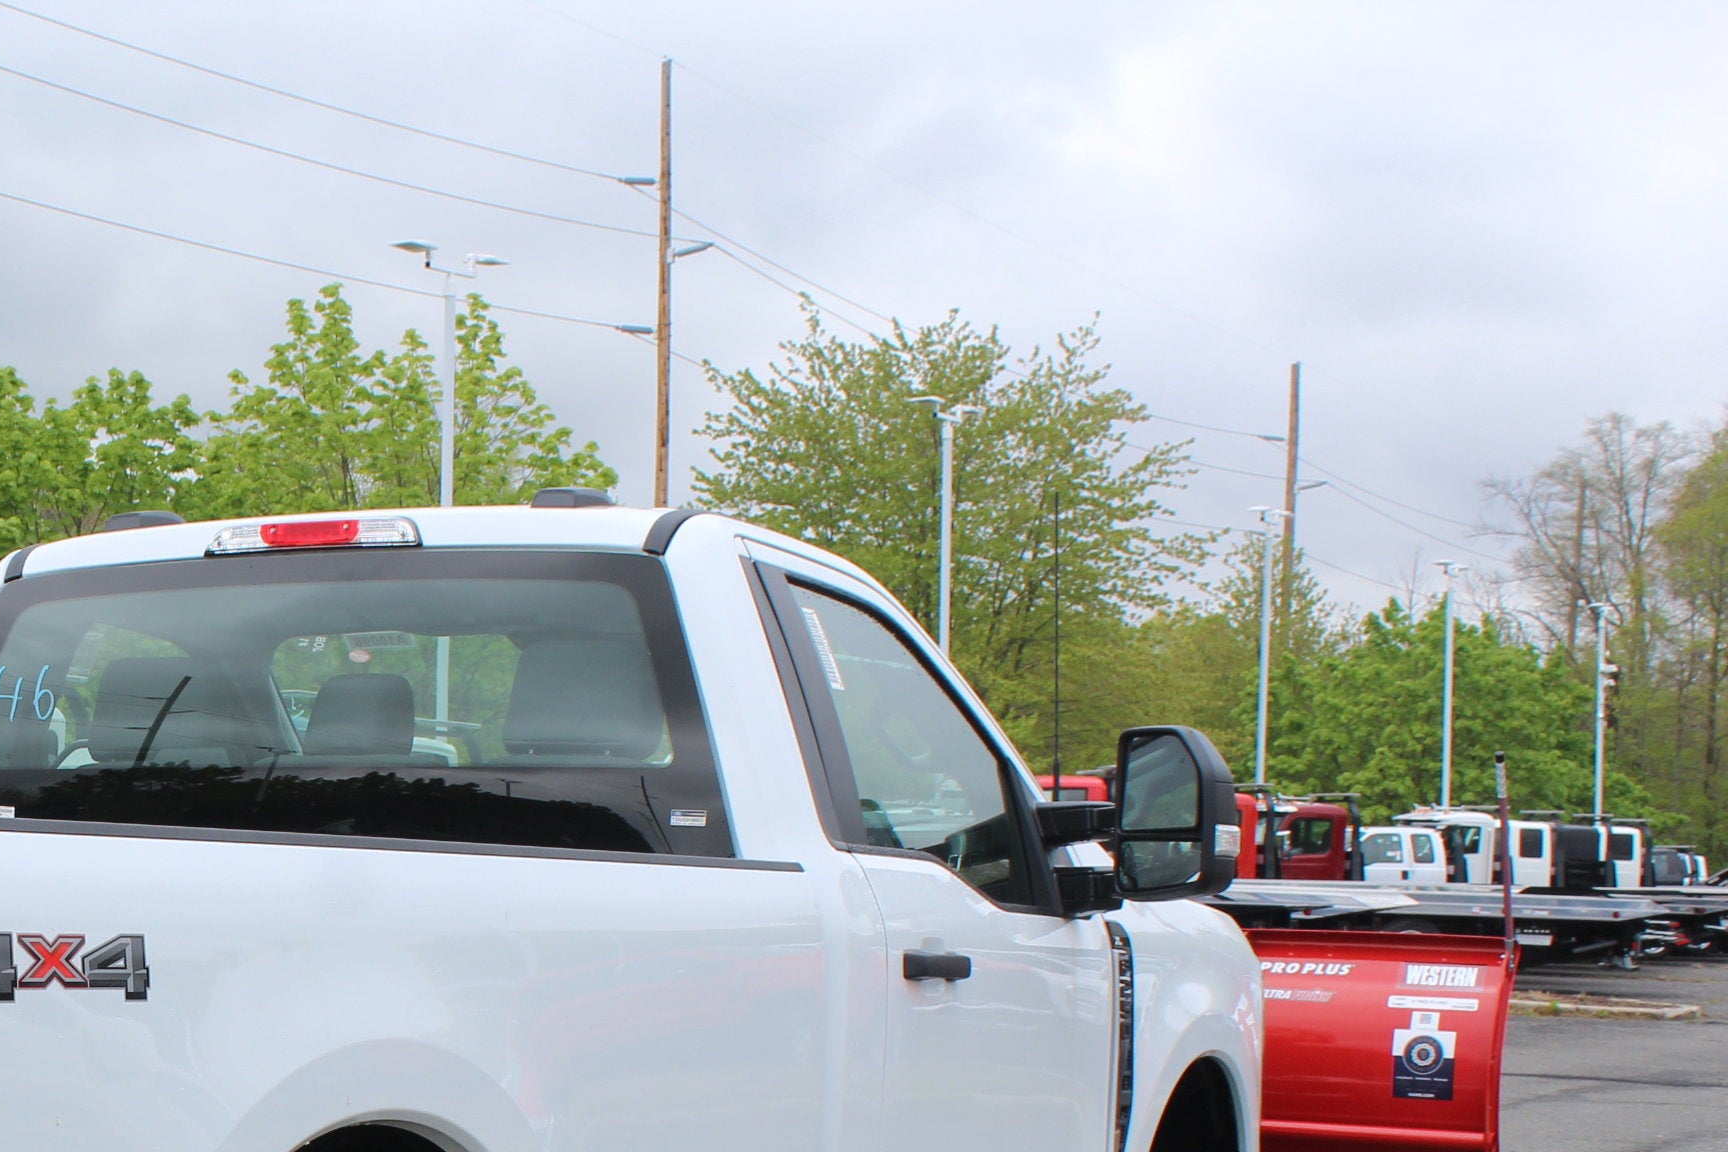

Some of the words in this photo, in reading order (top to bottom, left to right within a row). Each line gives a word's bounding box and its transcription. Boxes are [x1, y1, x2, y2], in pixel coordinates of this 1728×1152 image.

[1260, 961, 1301, 974] PRO
[1301, 963, 1353, 976] PLUS
[1405, 964, 1479, 987] WESTERN
